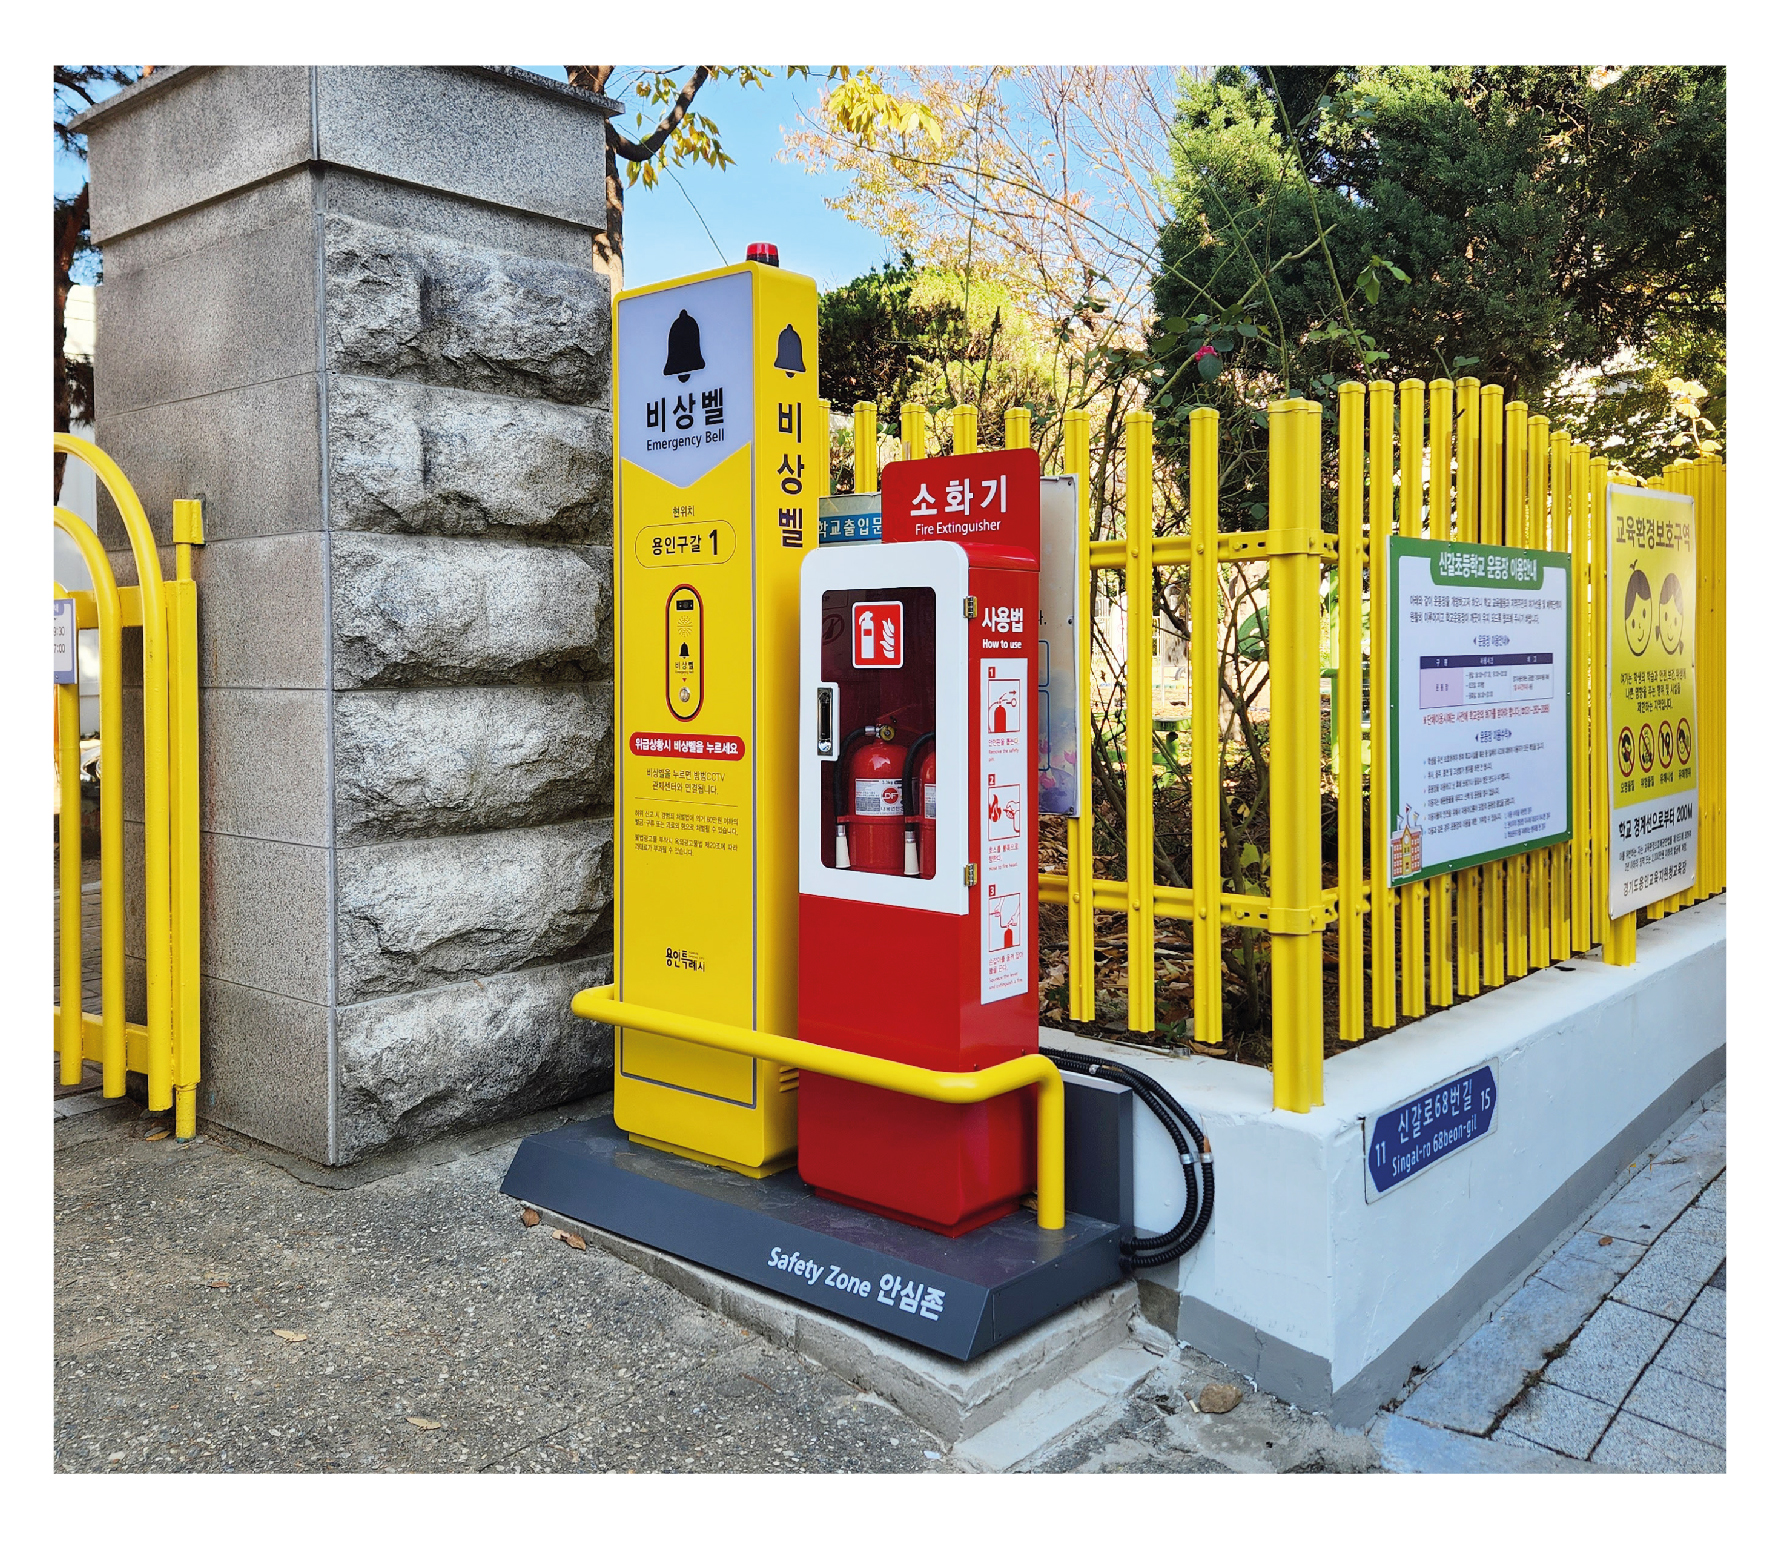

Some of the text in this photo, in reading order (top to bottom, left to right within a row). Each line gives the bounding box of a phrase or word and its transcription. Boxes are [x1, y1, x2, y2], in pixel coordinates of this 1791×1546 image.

[646, 387, 724, 432] 비상벨
[646, 428, 725, 451] Emergency Bell
[777, 402, 805, 548] 비상벨
[910, 474, 1007, 516] 소화기
[672, 505, 695, 519] 현위치
[819, 517, 882, 538] 학교출입문
[915, 520, 1002, 536] Fire Extinguisher
[1616, 515, 1690, 552] 교육환경보호구역
[652, 529, 718, 556] 용인구갈 1
[1439, 551, 1537, 582] 신갈초등학교 운동장 이용안내
[982, 606, 1023, 632] 사용법
[982, 639, 1000, 649] How
[1000, 639, 1009, 649] to
[989, 668, 995, 677] 1
[635, 738, 738, 754] 위급상황시 비상벨을 누르세요
[646, 768, 670, 780] 비상벨을
[673, 770, 692, 780] 누르면
[989, 775, 995, 785] 2
[652, 780, 719, 795] 관제센터와 연결됩니다.
[1618, 820, 1631, 841] 학교
[1634, 807, 1675, 838] 경계선으로부터
[1676, 803, 1693, 823] 200M
[989, 885, 995, 896] 3
[1623, 860, 1687, 897] 경기도용인교육지원청교육장
[1398, 1078, 1491, 1144] 신갈로68번길 15
[1375, 1114, 1477, 1177] 11 Singal-ro 68beon-gil
[767, 1246, 946, 1322] Safety Zone 안심존
